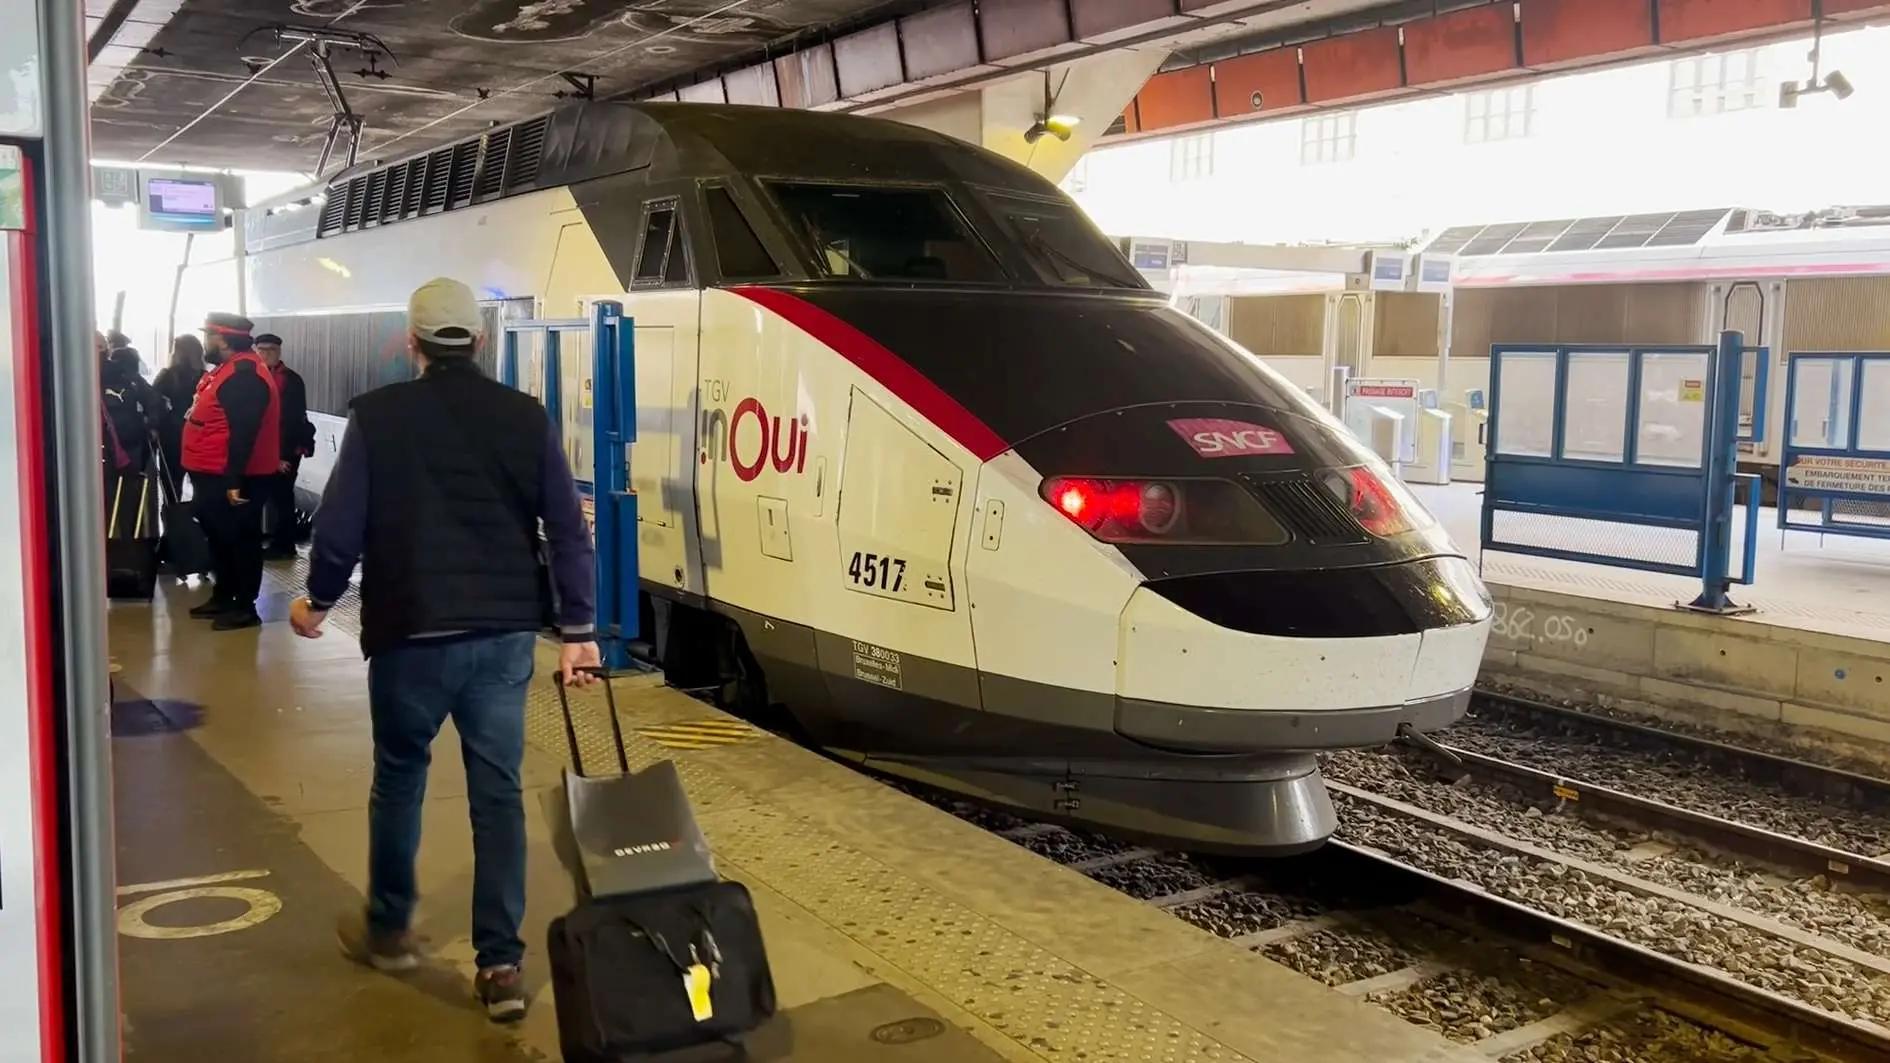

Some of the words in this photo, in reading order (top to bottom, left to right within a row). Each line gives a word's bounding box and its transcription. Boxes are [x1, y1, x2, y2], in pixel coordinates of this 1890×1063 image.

[704, 379, 730, 402] TGV
[1193, 430, 1278, 452] SNCF
[848, 551, 906, 592] 4517
[853, 640, 869, 654] TGV
[871, 646, 900, 664] 380033
